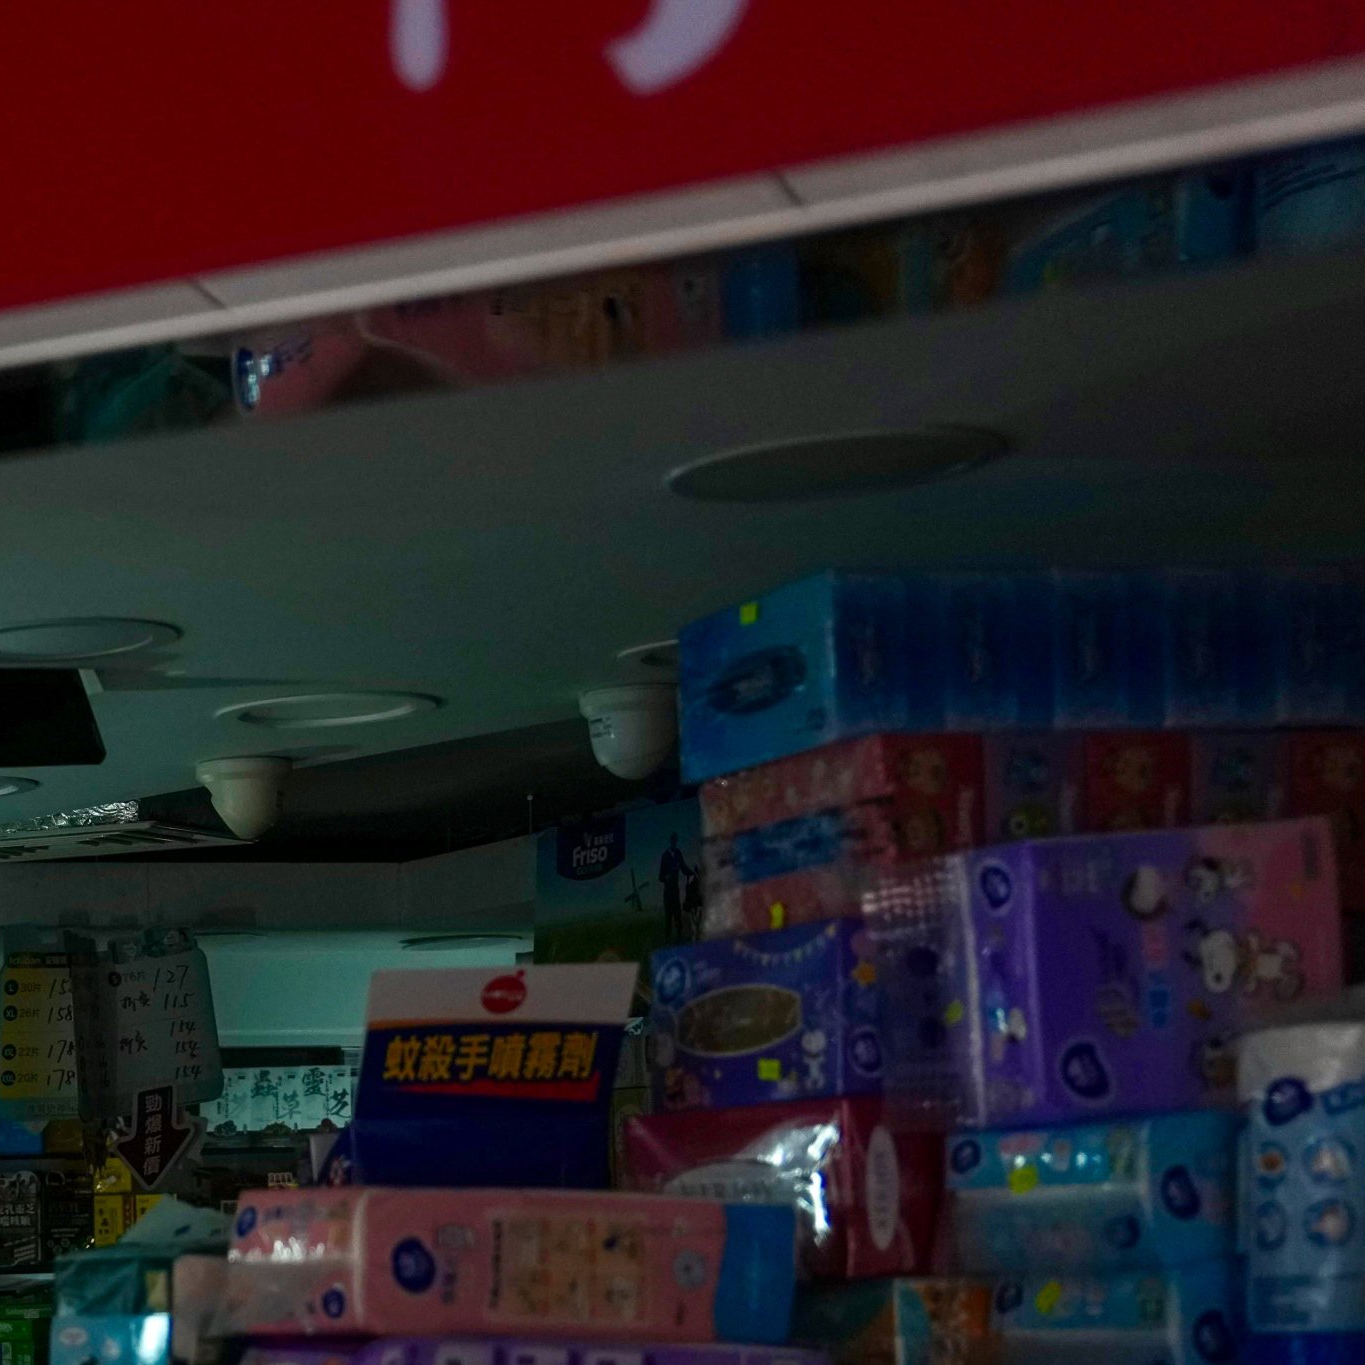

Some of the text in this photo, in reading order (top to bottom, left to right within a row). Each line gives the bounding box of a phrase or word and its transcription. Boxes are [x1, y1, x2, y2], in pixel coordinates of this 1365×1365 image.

[572, 846, 609, 868] Friso
[382, 1029, 598, 1084] 蚊殺手噴霧劑
